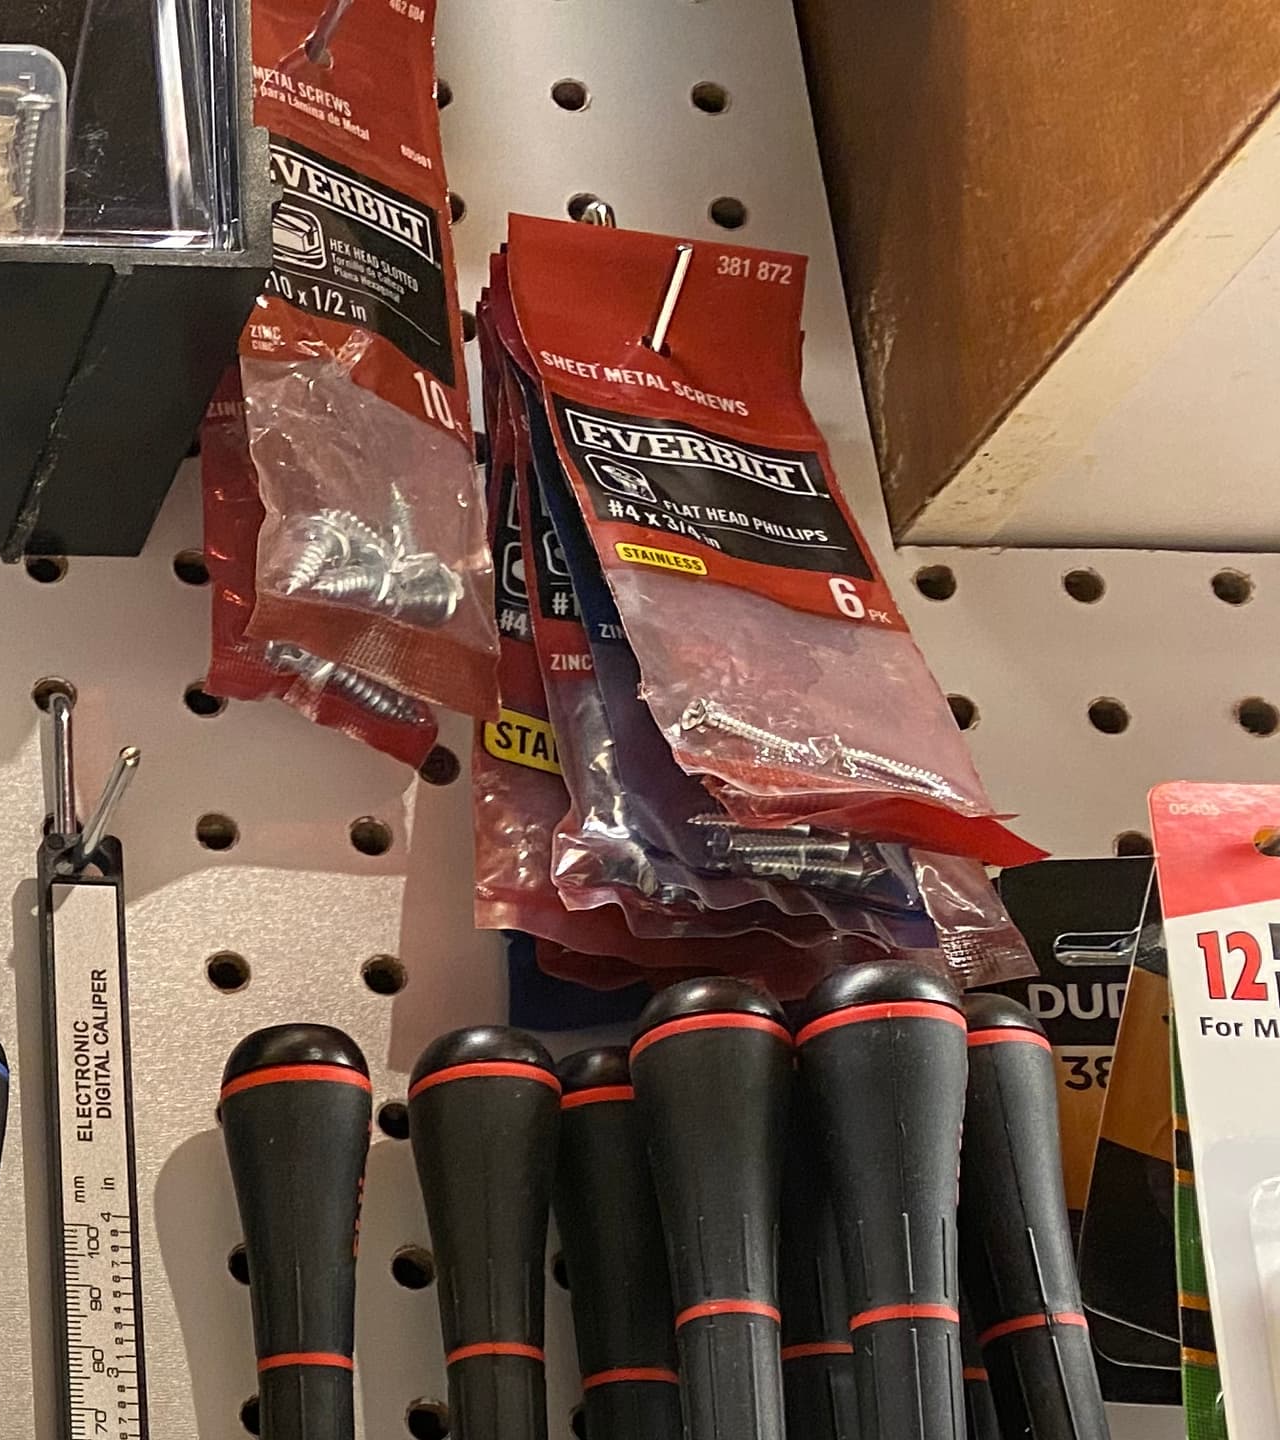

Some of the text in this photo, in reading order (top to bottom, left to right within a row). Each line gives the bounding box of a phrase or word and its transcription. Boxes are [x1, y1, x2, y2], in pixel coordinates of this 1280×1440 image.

[253, 65, 352, 117] METAL SCREWS
[342, 116, 370, 141] Metal
[329, 237, 419, 293] HEX HEAD SLOTTED
[717, 255, 792, 285] 381 872
[264, 270, 367, 322] 10 x 1/2 in
[249, 324, 281, 340] ZINC
[540, 350, 750, 417] SHEET METAL SCREWS
[413, 371, 455, 430] 10
[577, 419, 796, 488] EVERBILT
[607, 499, 721, 549] #4 x 3/4 in
[663, 499, 829, 542] FLAT HEAD PHILLIPS
[623, 546, 703, 573] STAINLESS
[828, 577, 892, 625] 6 PK
[499, 609, 528, 636] #4
[550, 654, 593, 671] ZINC
[1196, 930, 1269, 1001] 12
[1200, 1016, 1243, 1037] For
[91, 968, 112, 1119] DIGITAL CALIPER
[73, 1019, 93, 1142] ELECTRONIC
[73, 1175, 86, 1204] mm
[100, 1176, 115, 1191] in
[100, 1212, 112, 1222] 4
[87, 1226, 100, 1259] 100
[90, 1287, 102, 1311] 90
[92, 1349, 105, 1373] 80
[106, 1367, 119, 1379] 3
[95, 1410, 108, 1435] 70
